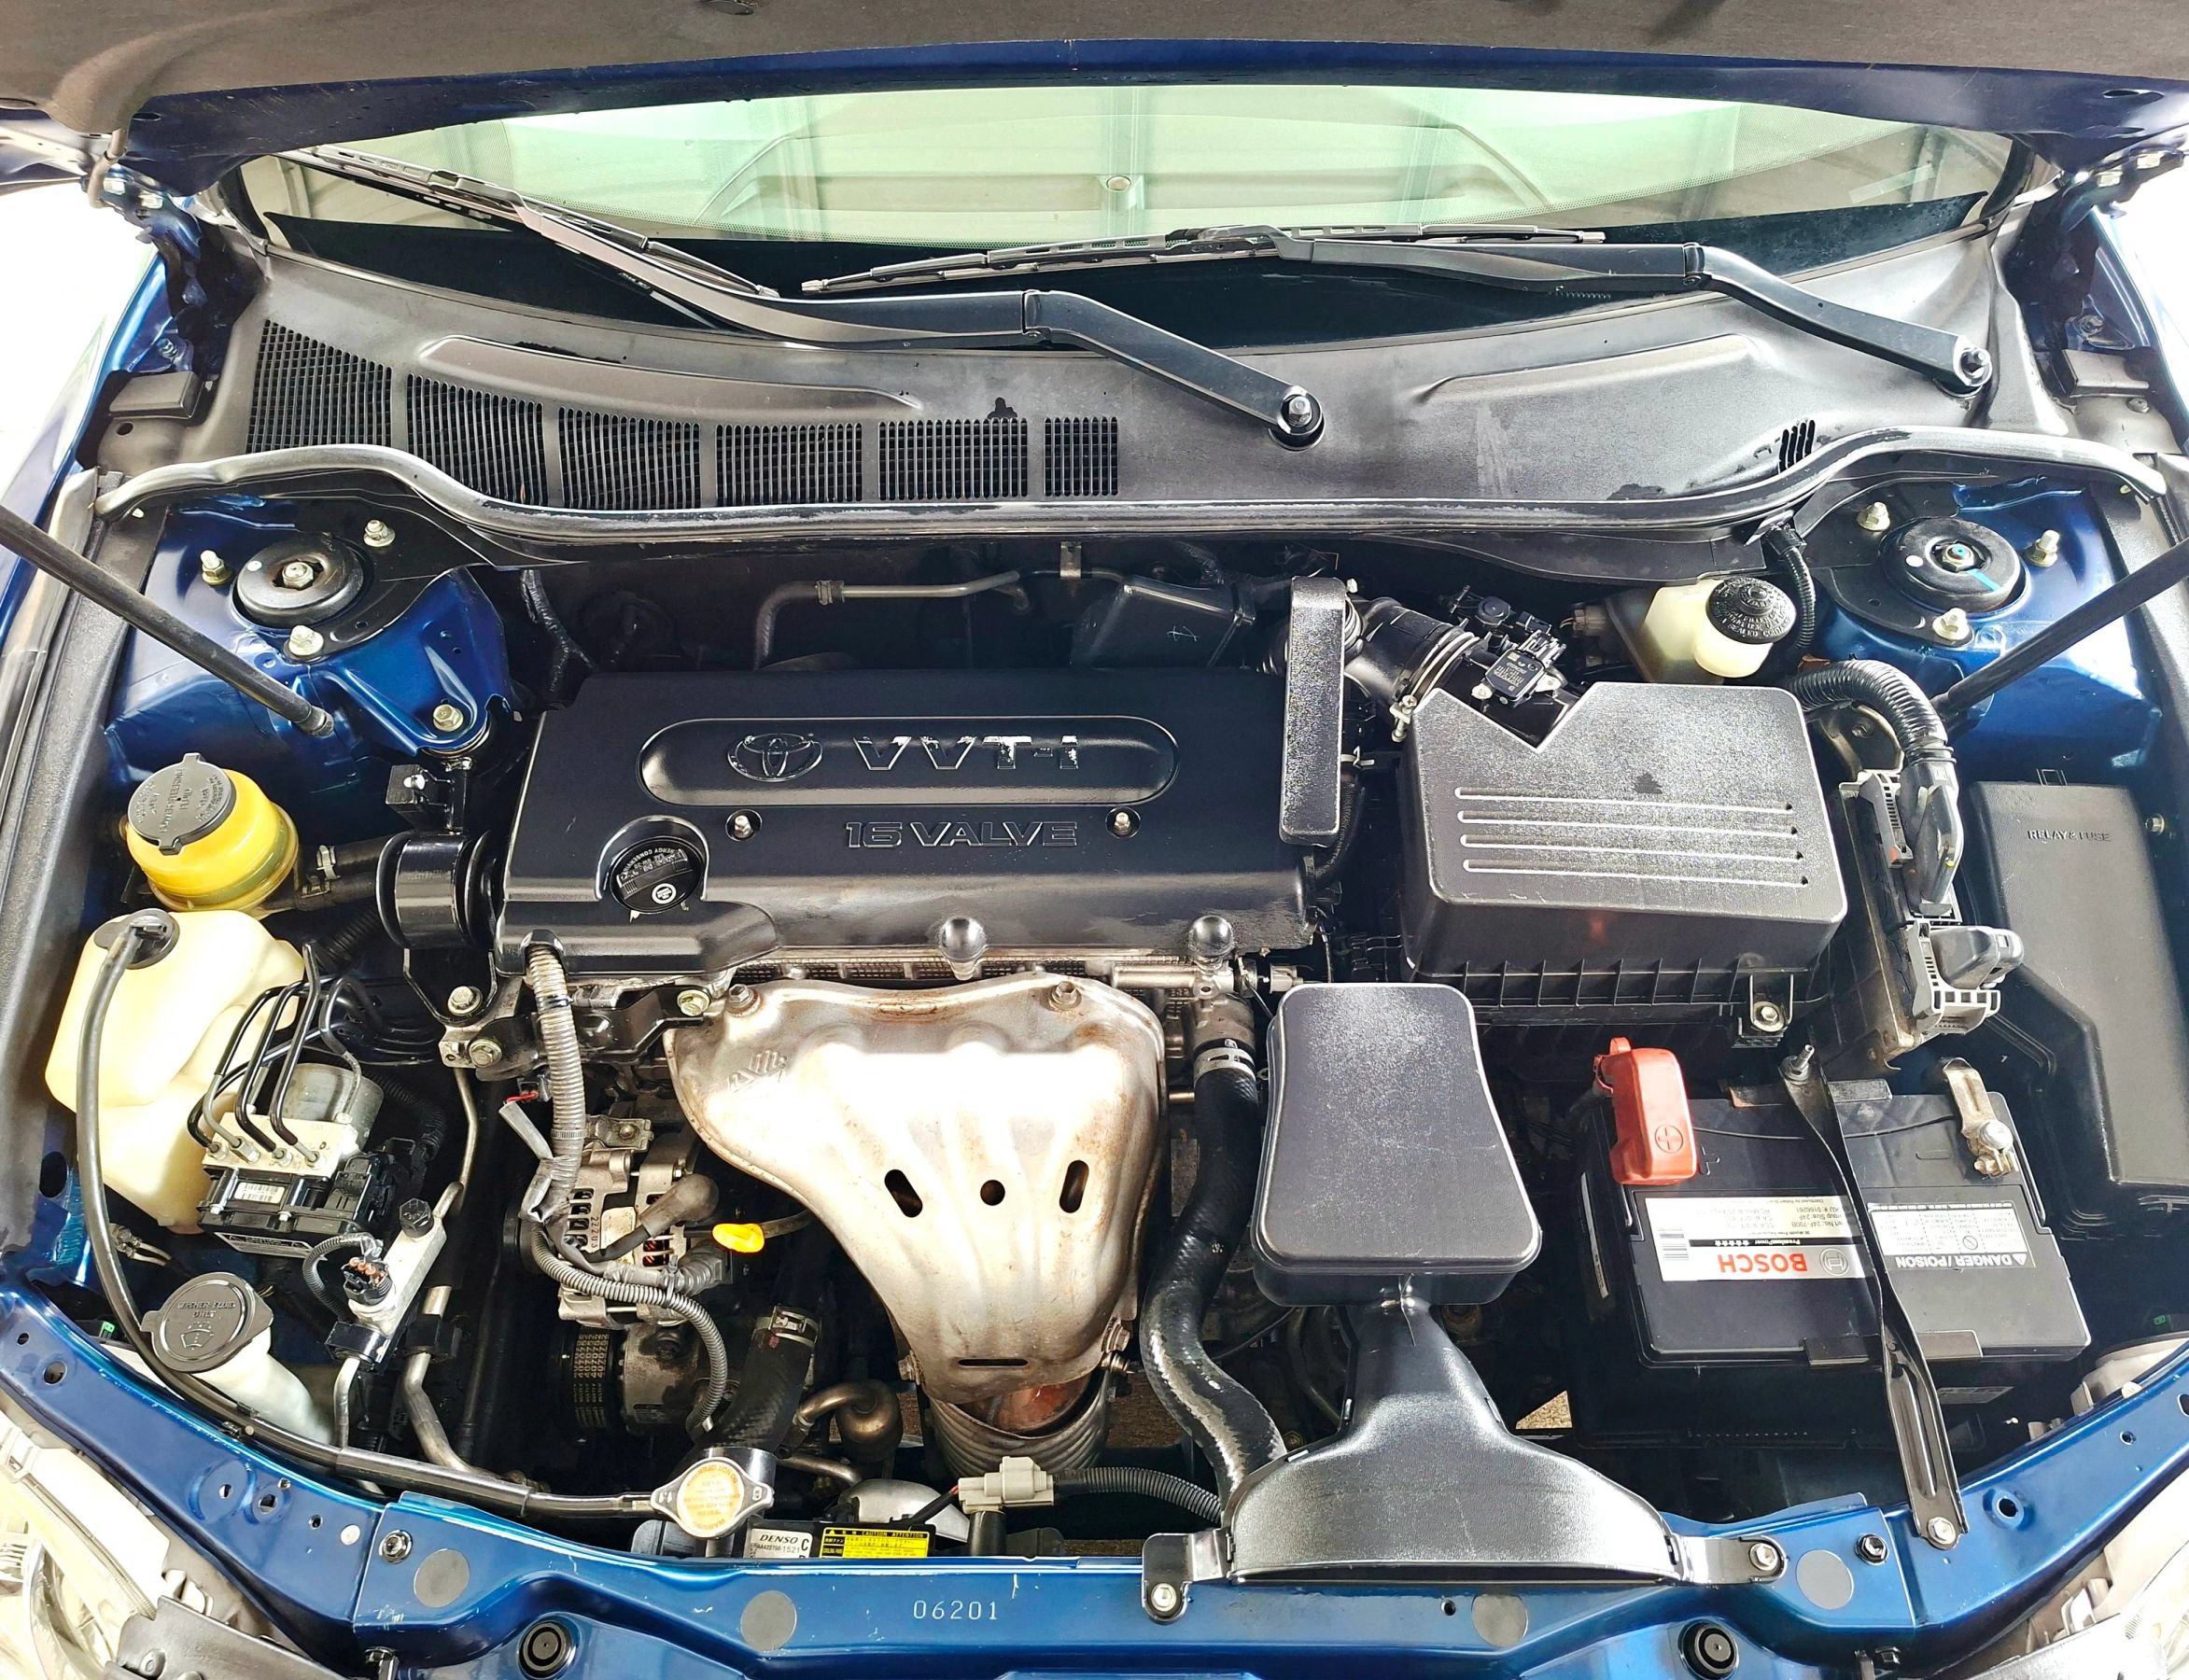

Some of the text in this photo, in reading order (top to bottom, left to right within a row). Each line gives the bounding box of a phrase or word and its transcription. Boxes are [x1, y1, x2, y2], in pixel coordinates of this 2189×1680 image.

[846, 821, 1078, 848] 16 VALVE
[2028, 830, 2067, 841] RELAY
[2079, 832, 2111, 842] FUSE
[1717, 1253, 1808, 1273] BOSCH
[760, 1534, 809, 1551] DENSO C
[913, 1600, 997, 1620] 06201
